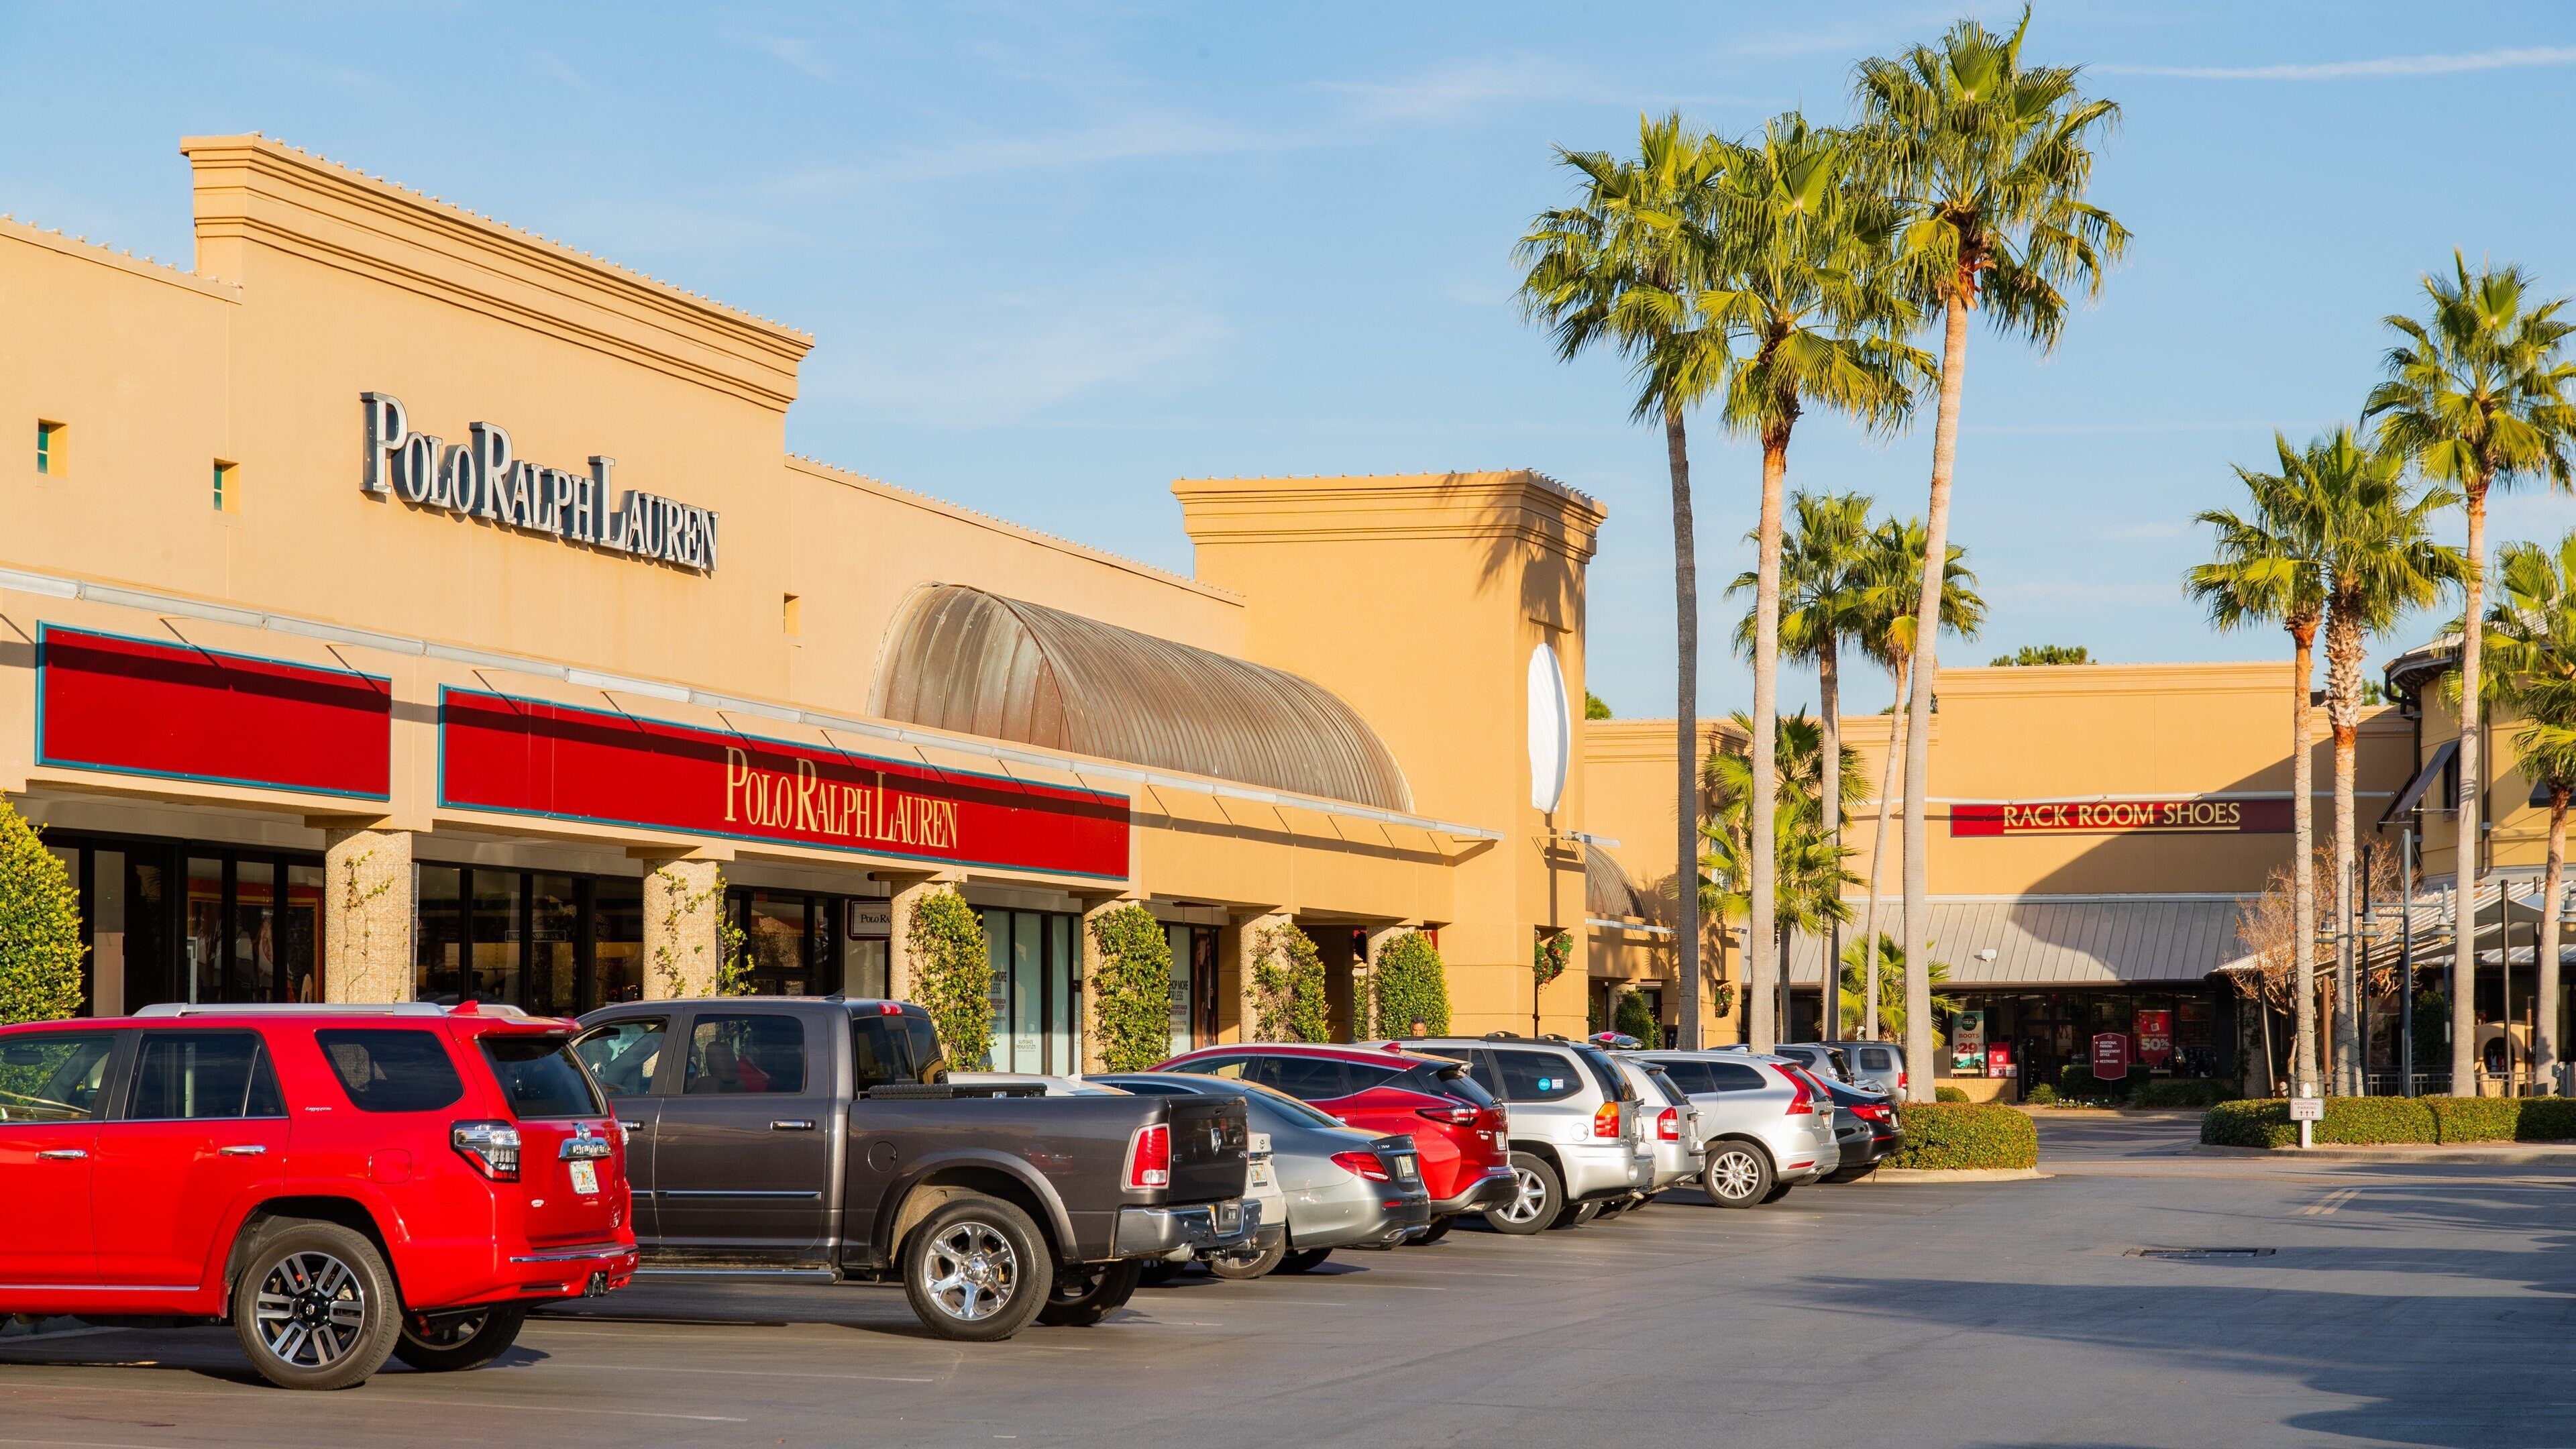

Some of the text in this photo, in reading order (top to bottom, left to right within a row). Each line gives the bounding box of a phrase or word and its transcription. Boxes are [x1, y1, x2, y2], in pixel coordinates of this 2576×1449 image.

[360, 392, 719, 572] POLO RALPH LAUREN
[724, 746, 958, 849] POLO RALPH LAUREN
[2003, 802, 2241, 827] RACK ROOM SHOES
[861, 914, 879, 923] POLO
[994, 971, 1007, 982] MORE
[991, 983, 1001, 994] LESS
[1178, 980, 1188, 990] MORE
[1175, 991, 1183, 1001] LESS
